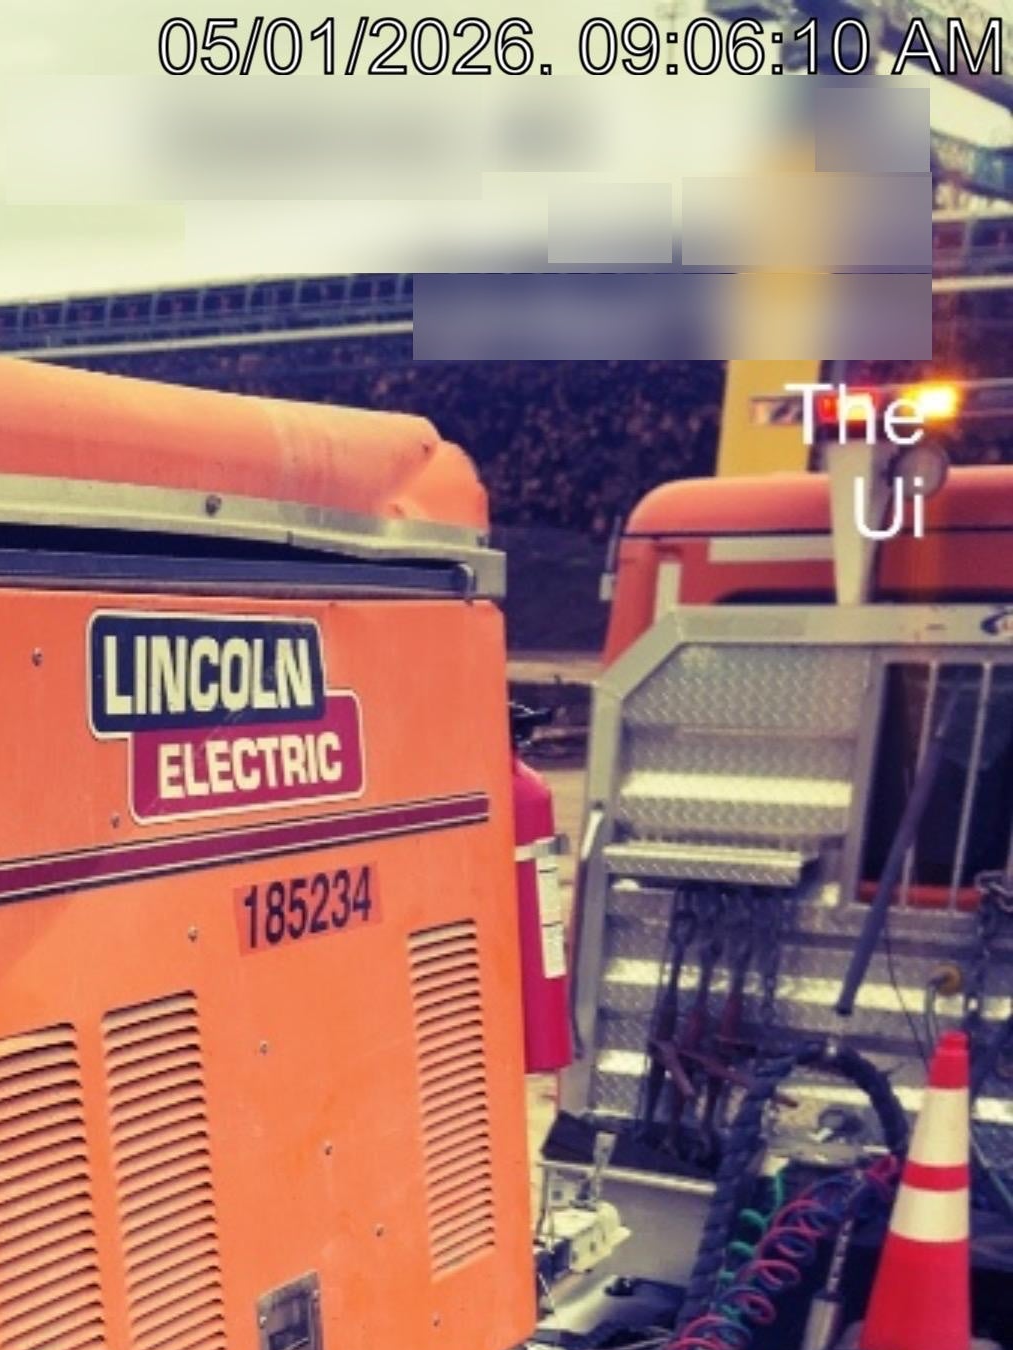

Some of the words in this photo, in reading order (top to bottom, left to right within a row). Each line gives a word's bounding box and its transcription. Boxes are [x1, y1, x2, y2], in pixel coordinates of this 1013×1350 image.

[103, 635, 314, 716] LINCOLN
[159, 731, 343, 799] ELECTRIC
[244, 866, 372, 948] 185234
